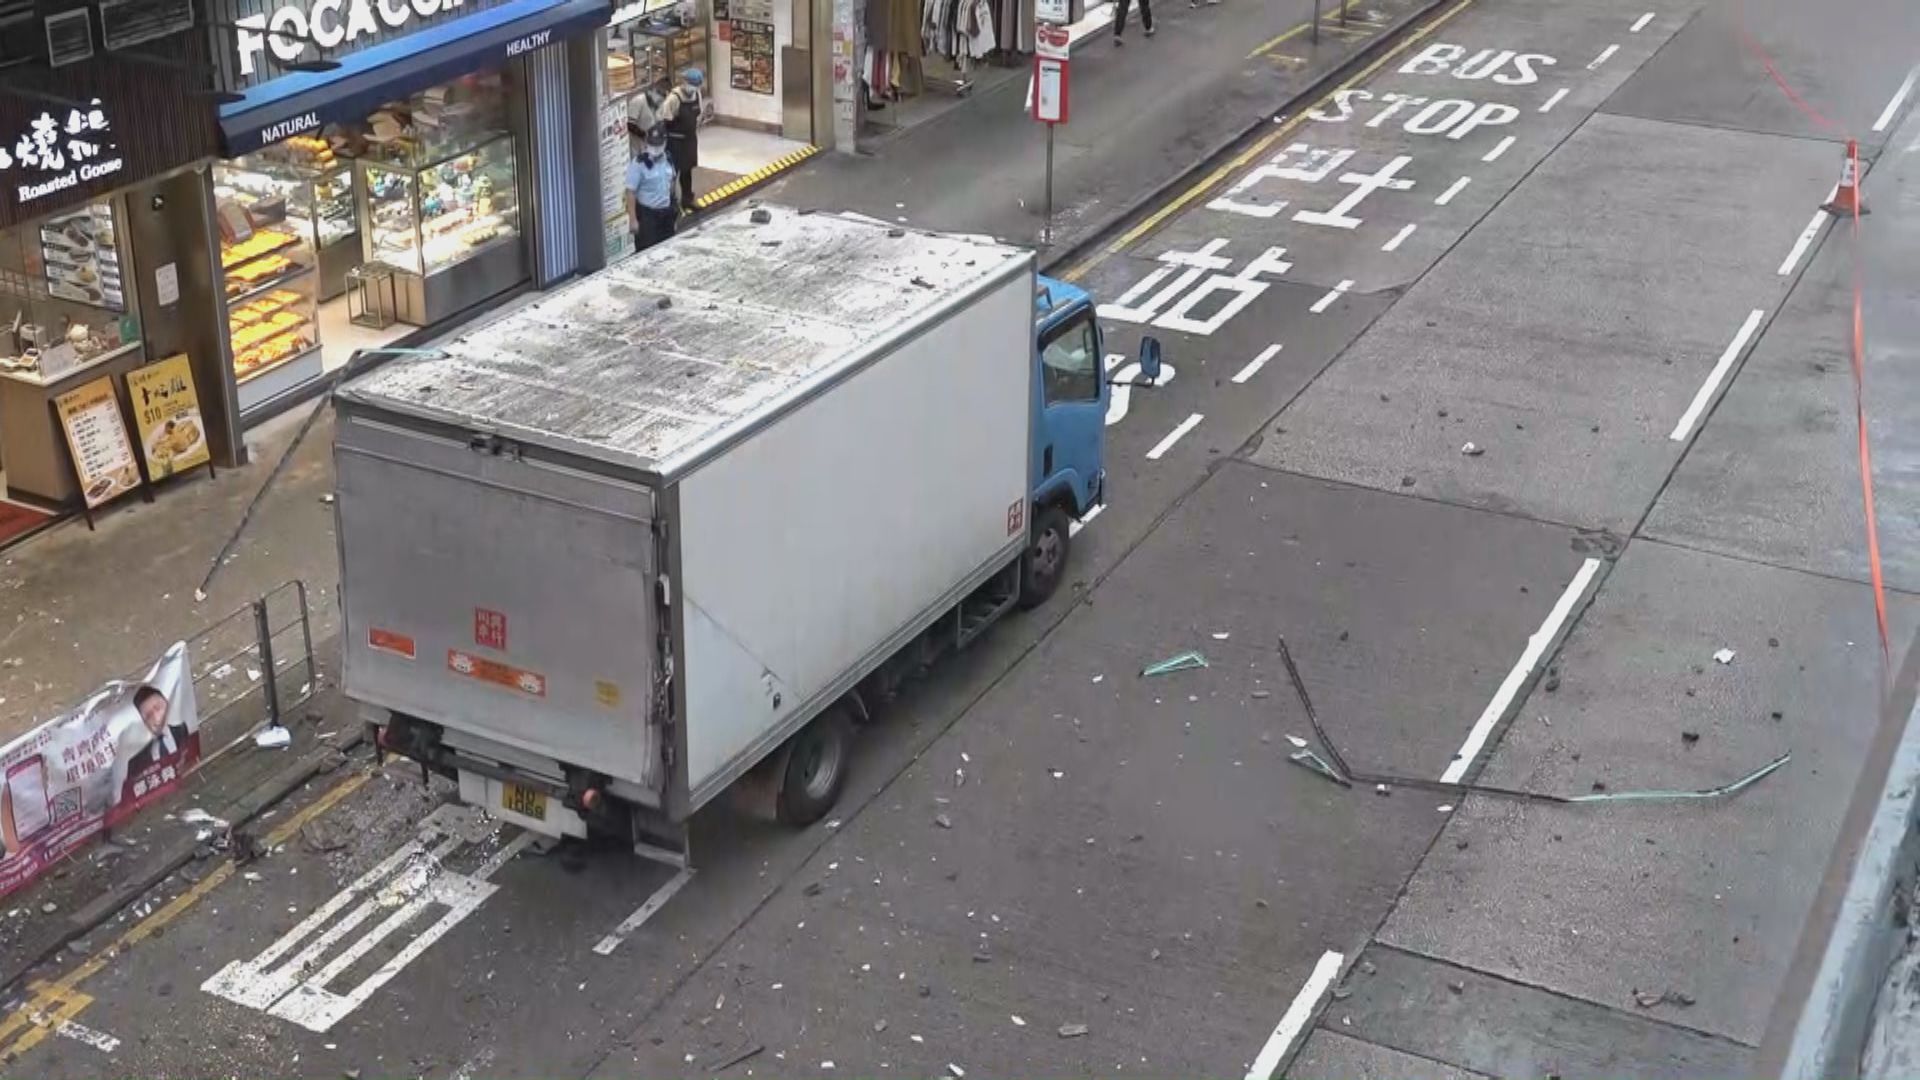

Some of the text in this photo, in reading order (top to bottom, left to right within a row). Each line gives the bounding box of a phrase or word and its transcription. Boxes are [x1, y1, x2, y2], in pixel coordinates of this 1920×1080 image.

[506, 30, 551, 57] HEALTHY
[1397, 43, 1557, 85] BUS
[261, 112, 320, 144] NATURAL
[1307, 89, 1520, 140] STOP
[18, 157, 122, 203] Roasted Goose
[1205, 143, 1416, 229] 巴士
[1097, 237, 1293, 335] 站
